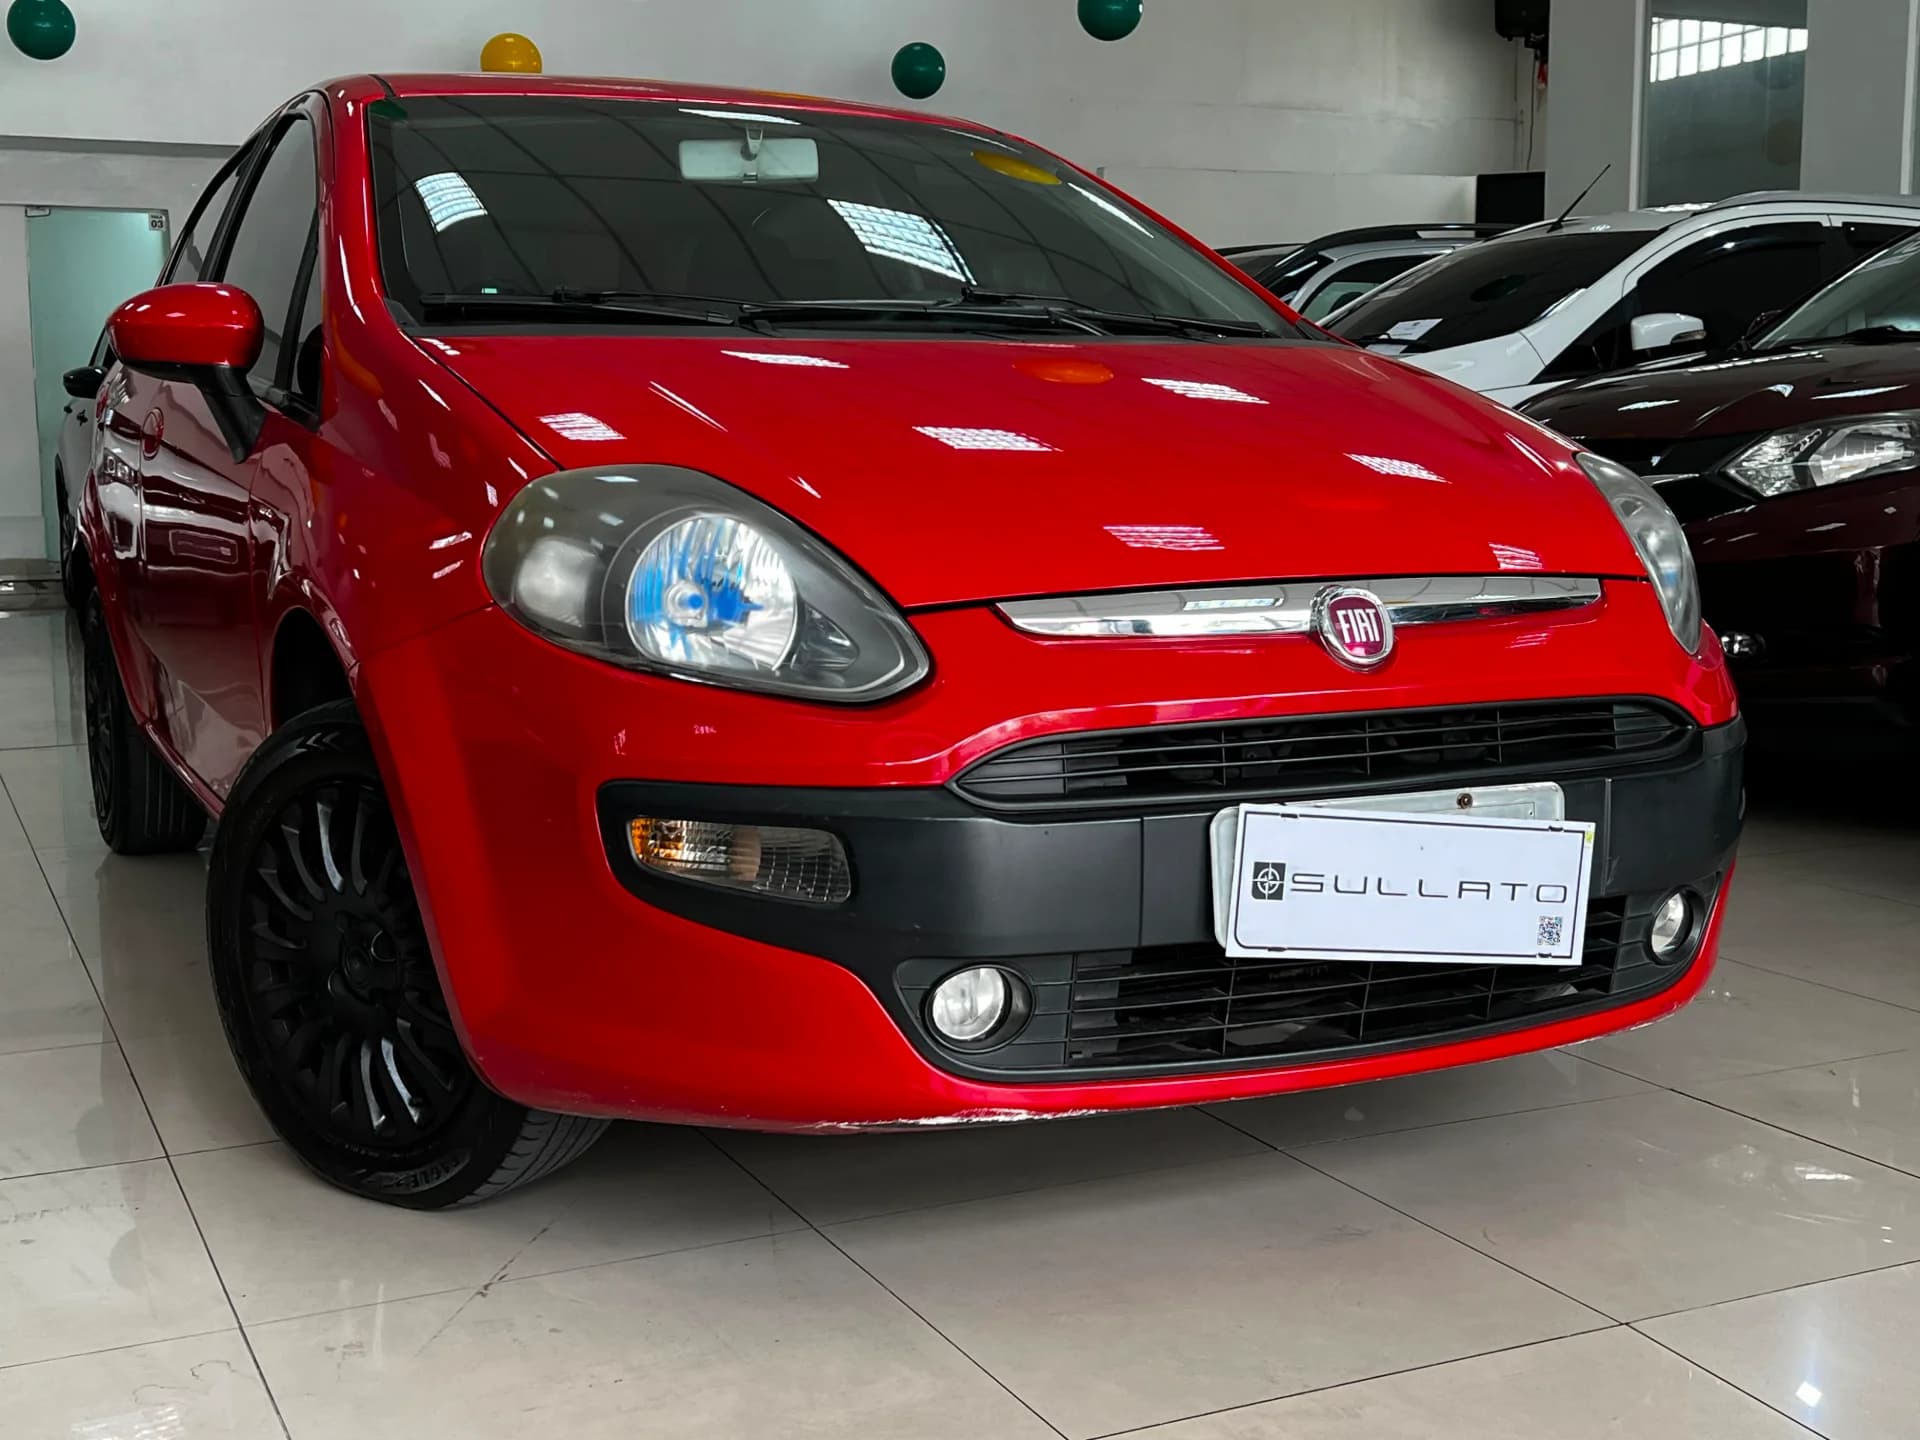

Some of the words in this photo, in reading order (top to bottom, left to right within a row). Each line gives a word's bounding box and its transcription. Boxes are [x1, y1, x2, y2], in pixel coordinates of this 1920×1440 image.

[151, 219, 164, 228] 03
[1336, 608, 1381, 644] FIAT
[1290, 873, 1568, 903] SULLATO
